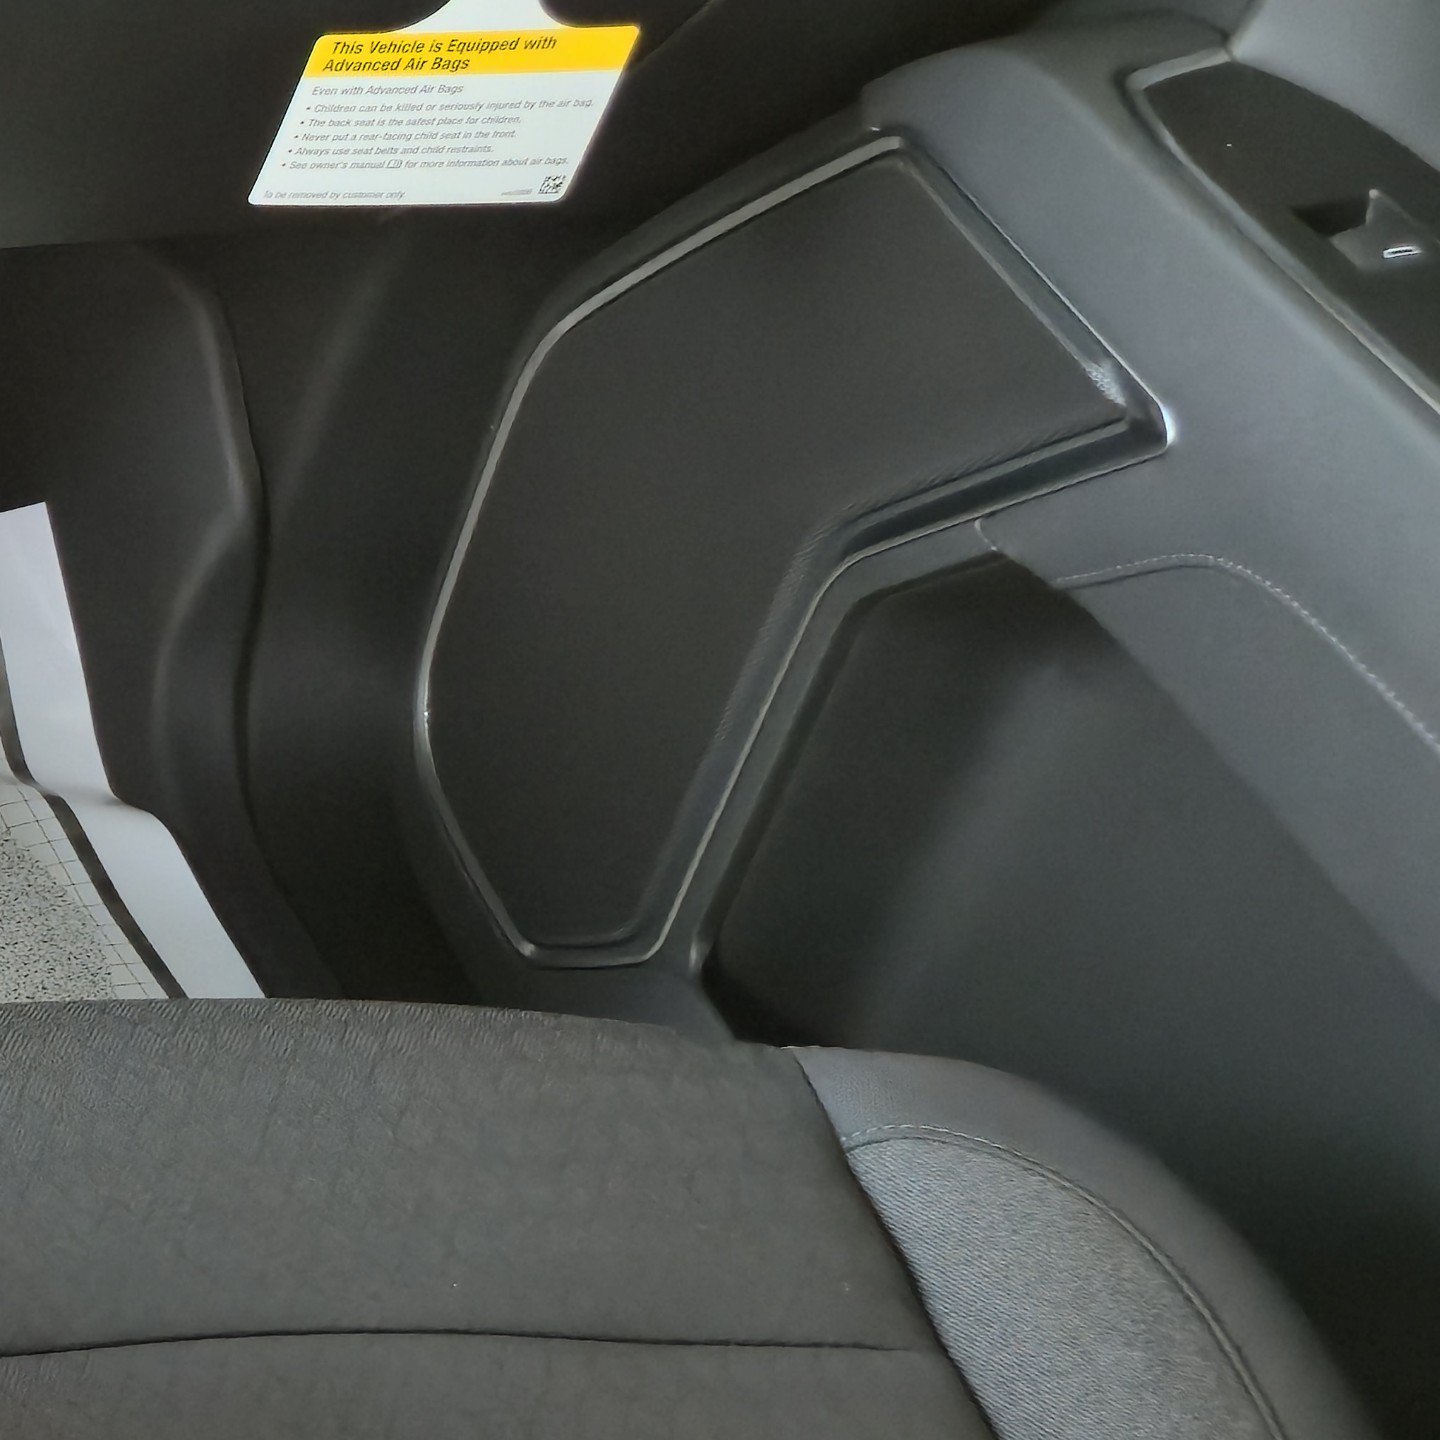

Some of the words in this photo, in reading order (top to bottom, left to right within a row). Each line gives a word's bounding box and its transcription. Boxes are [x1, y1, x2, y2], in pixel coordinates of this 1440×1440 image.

[332, 41, 363, 55] This
[370, 40, 427, 54] Vehicle
[429, 39, 443, 53] is
[447, 37, 520, 54] Equipped
[523, 35, 559, 50] with
[322, 58, 402, 72] Advanced
[403, 57, 428, 71] Air
[431, 56, 470, 73] Bags
[312, 86, 337, 96] Even
[340, 85, 364, 95] with
[365, 84, 418, 95] Advanced
[419, 84, 435, 94] Air
[438, 84, 464, 96] Bags
[314, 104, 357, 113] Children
[358, 104, 378, 112] can
[380, 103, 393, 112] be
[396, 103, 423, 112] killed
[425, 103, 436, 111] or
[440, 101, 484, 112] seriously
[486, 100, 521, 111] injured
[524, 100, 536, 110] by
[538, 100, 556, 108] the
[556, 99, 571, 108] air
